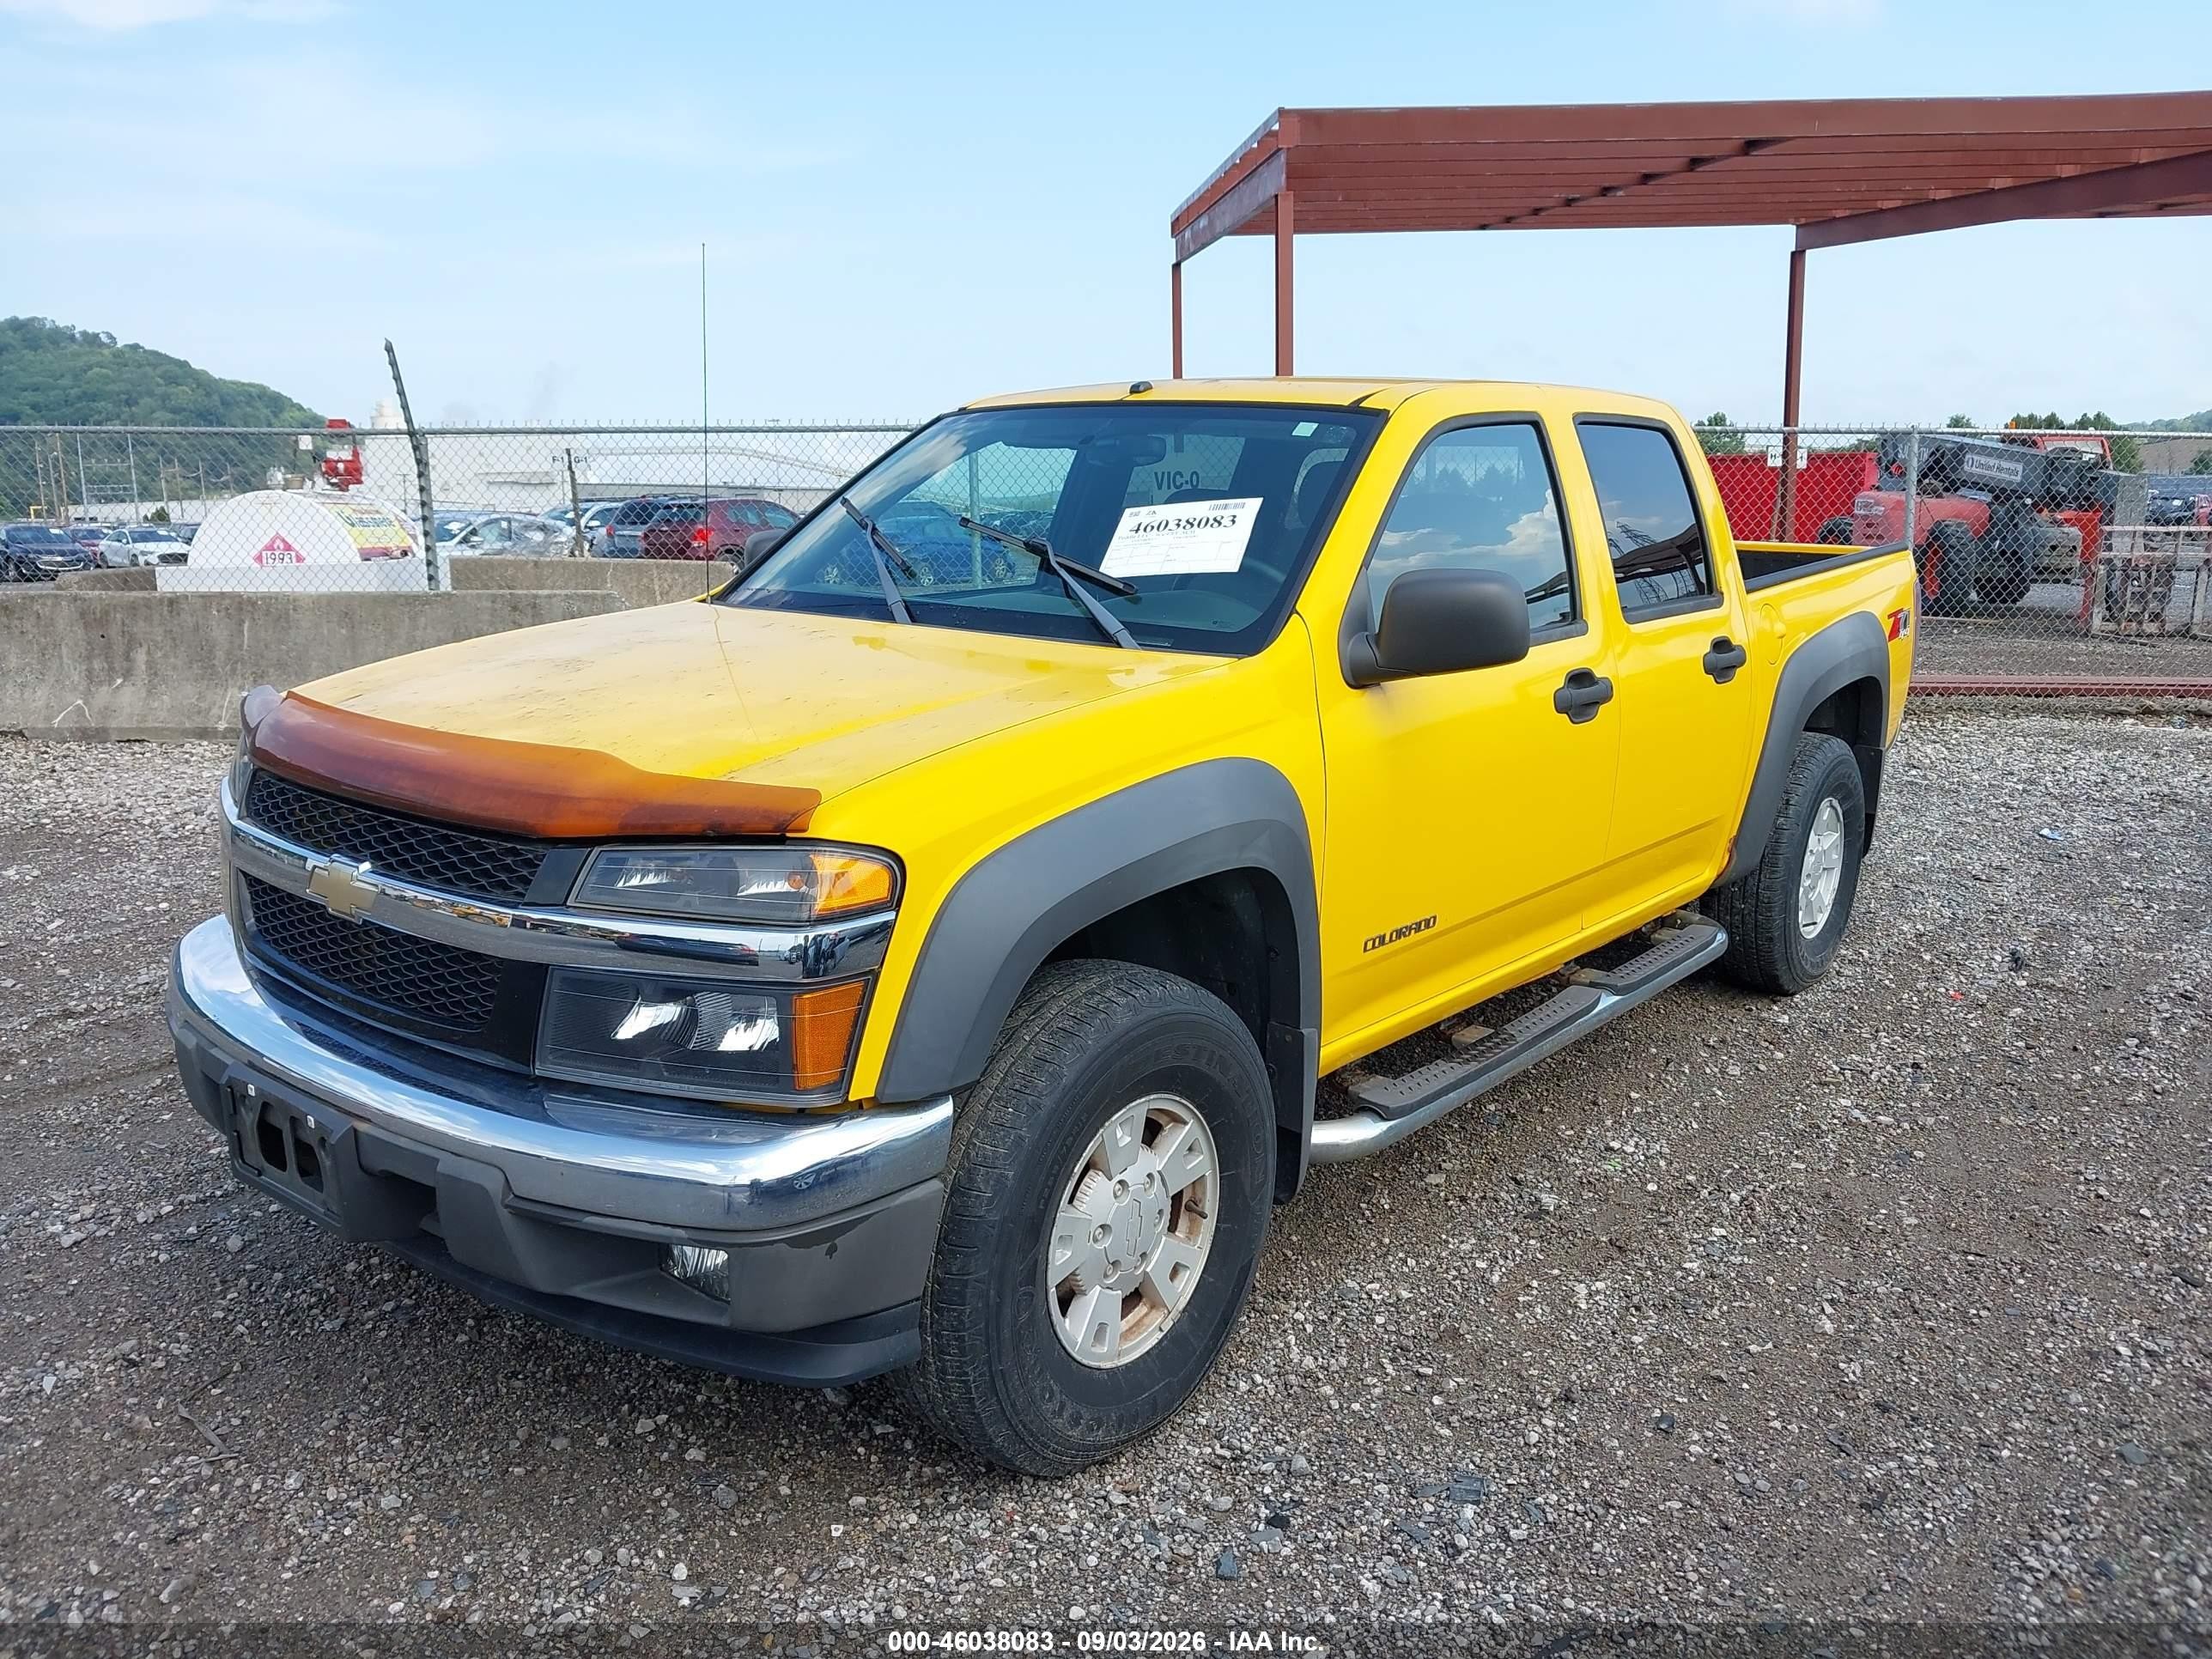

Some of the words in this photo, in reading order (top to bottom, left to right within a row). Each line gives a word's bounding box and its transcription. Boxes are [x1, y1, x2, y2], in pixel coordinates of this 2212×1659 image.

[1975, 459, 1996, 471] United
[1128, 514, 1237, 534] 46038083
[265, 552, 293, 565] 1993
[1364, 915, 1437, 953] COLORADO
